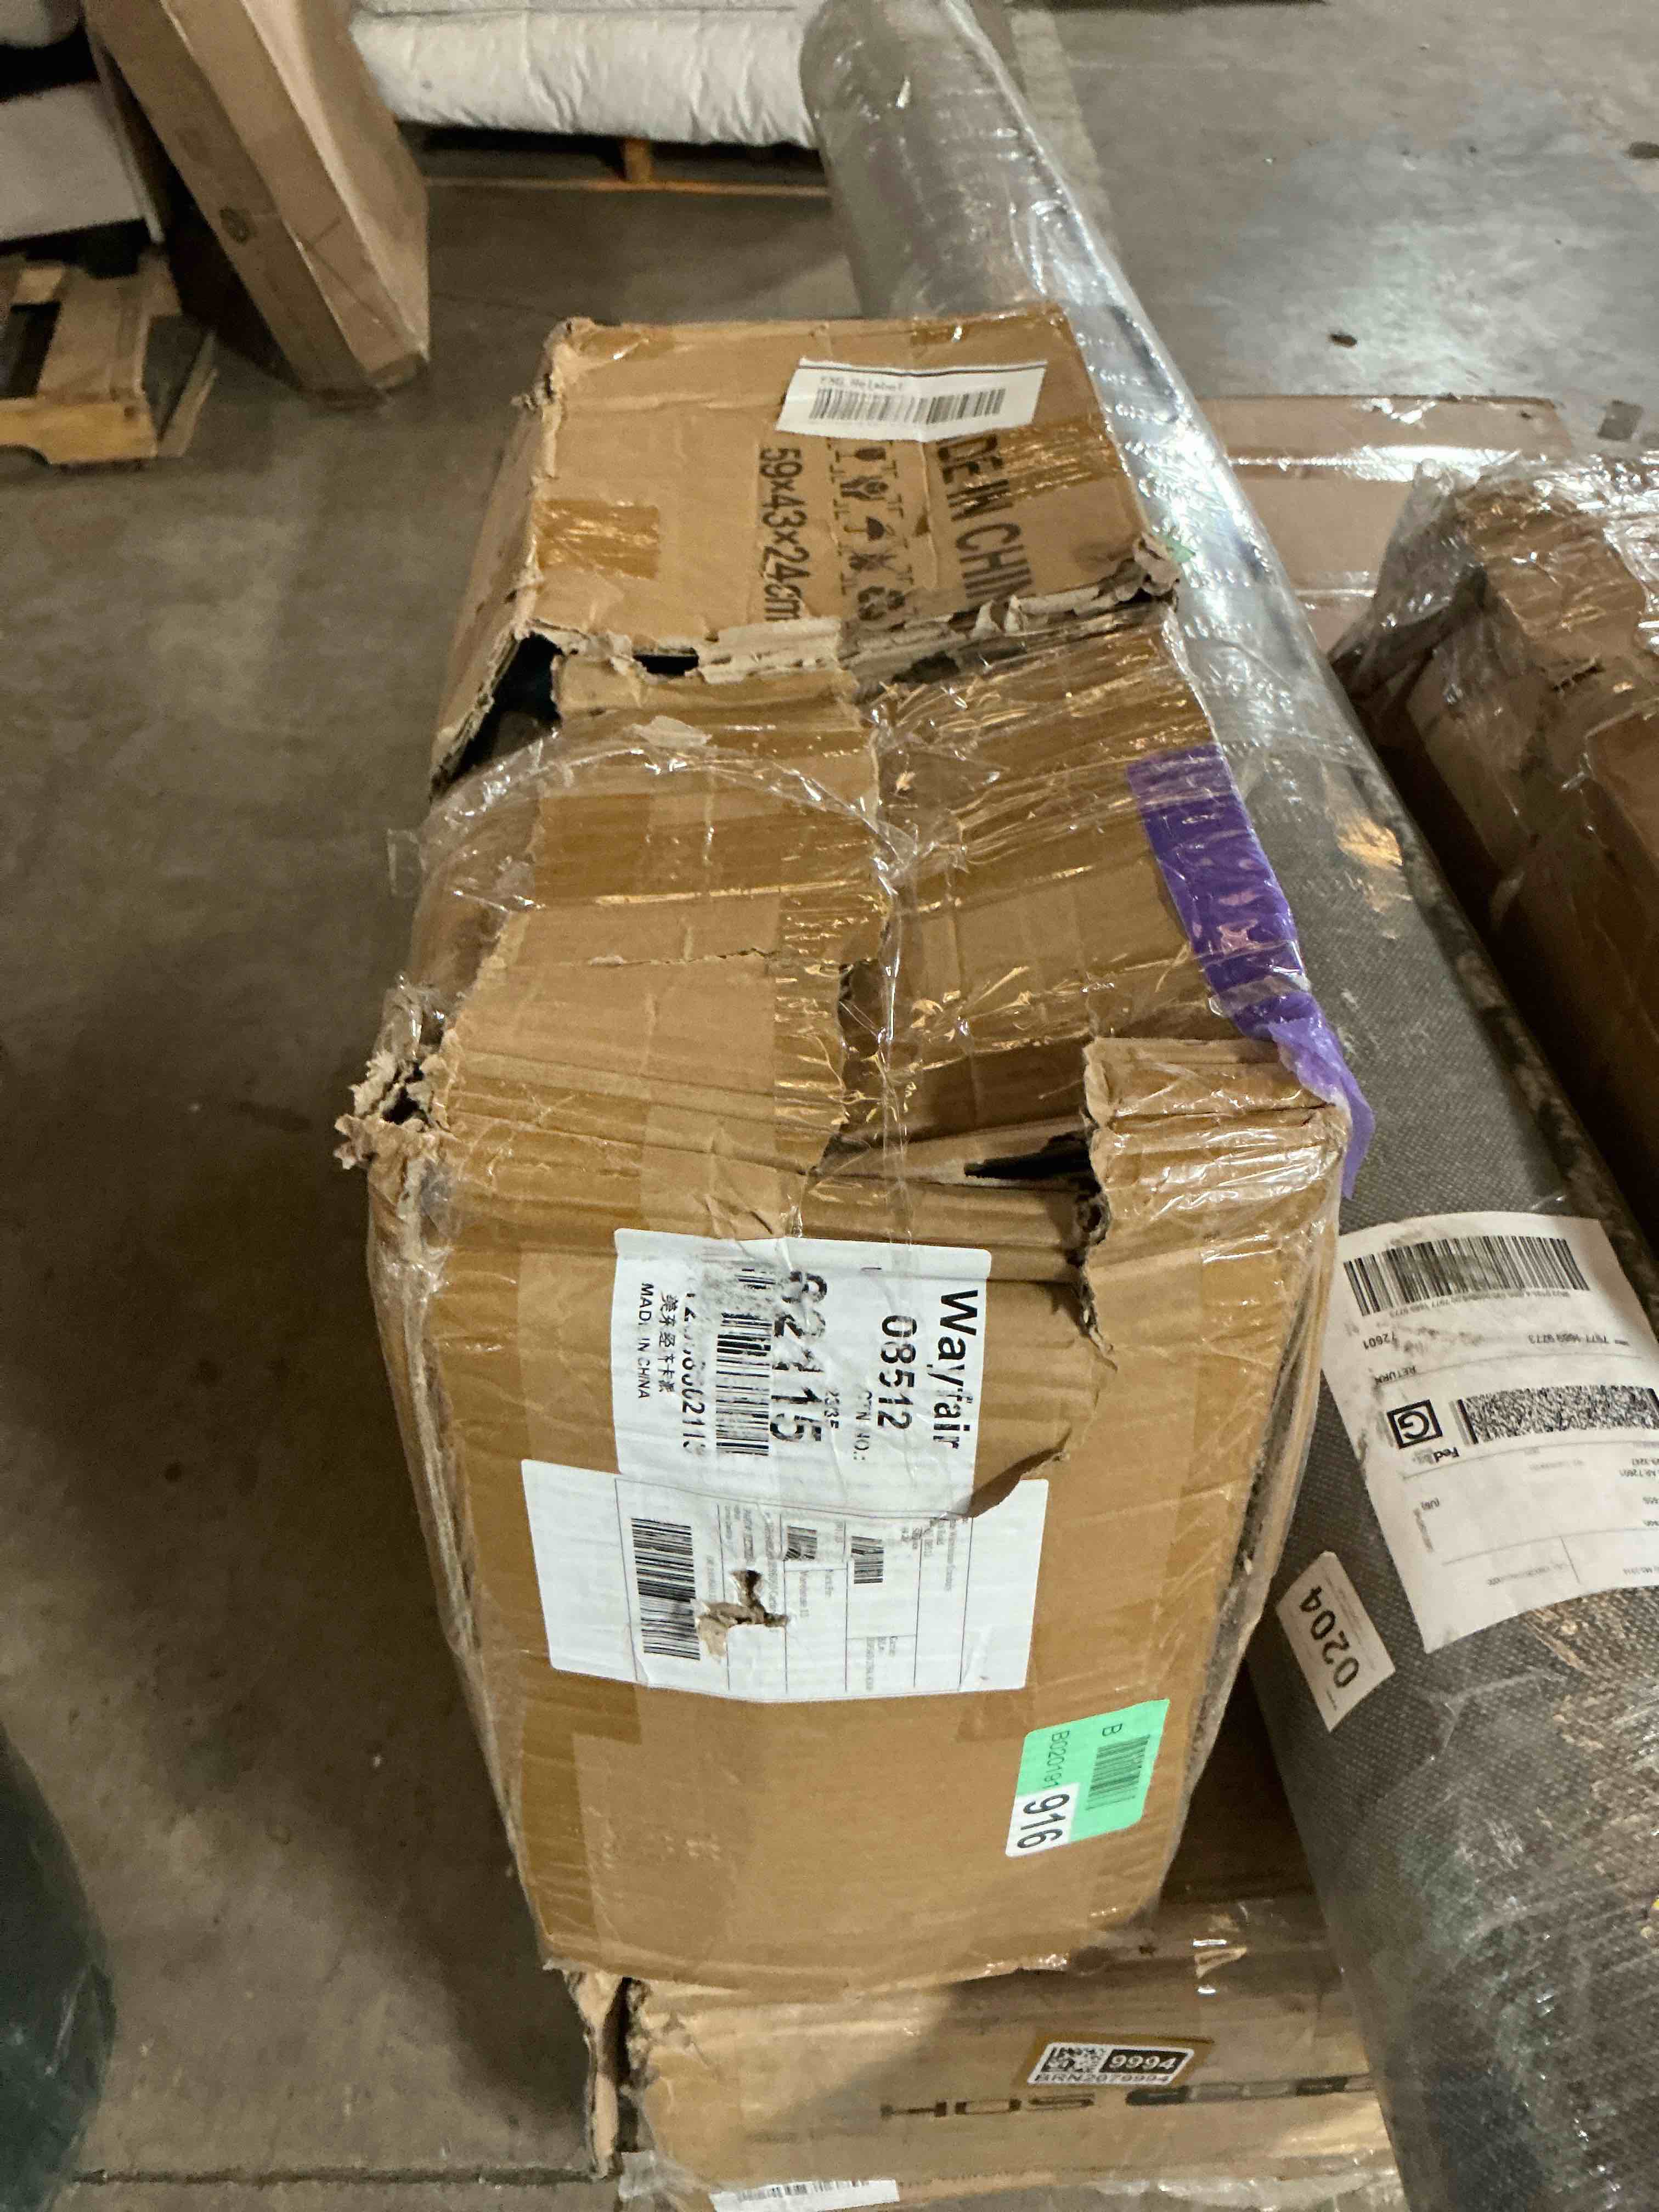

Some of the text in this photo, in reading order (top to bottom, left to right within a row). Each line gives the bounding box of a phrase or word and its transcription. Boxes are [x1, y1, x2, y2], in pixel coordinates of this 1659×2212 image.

[935, 433, 1032, 602] DE IN CHIN
[637, 1283, 654, 1399] MAD IN CHINA
[1363, 1331, 1396, 1350] 72601
[877, 1314, 918, 1430] 08512
[927, 1289, 979, 1450] Wayfair
[1374, 1364, 1417, 1385] RETURN
[1397, 1410, 1429, 1440] G
[1299, 1585, 1359, 1688] 0204
[1102, 1723, 1123, 1737] B
[1017, 1794, 1070, 1848] 916
[1108, 2055, 1178, 2071] 9994
